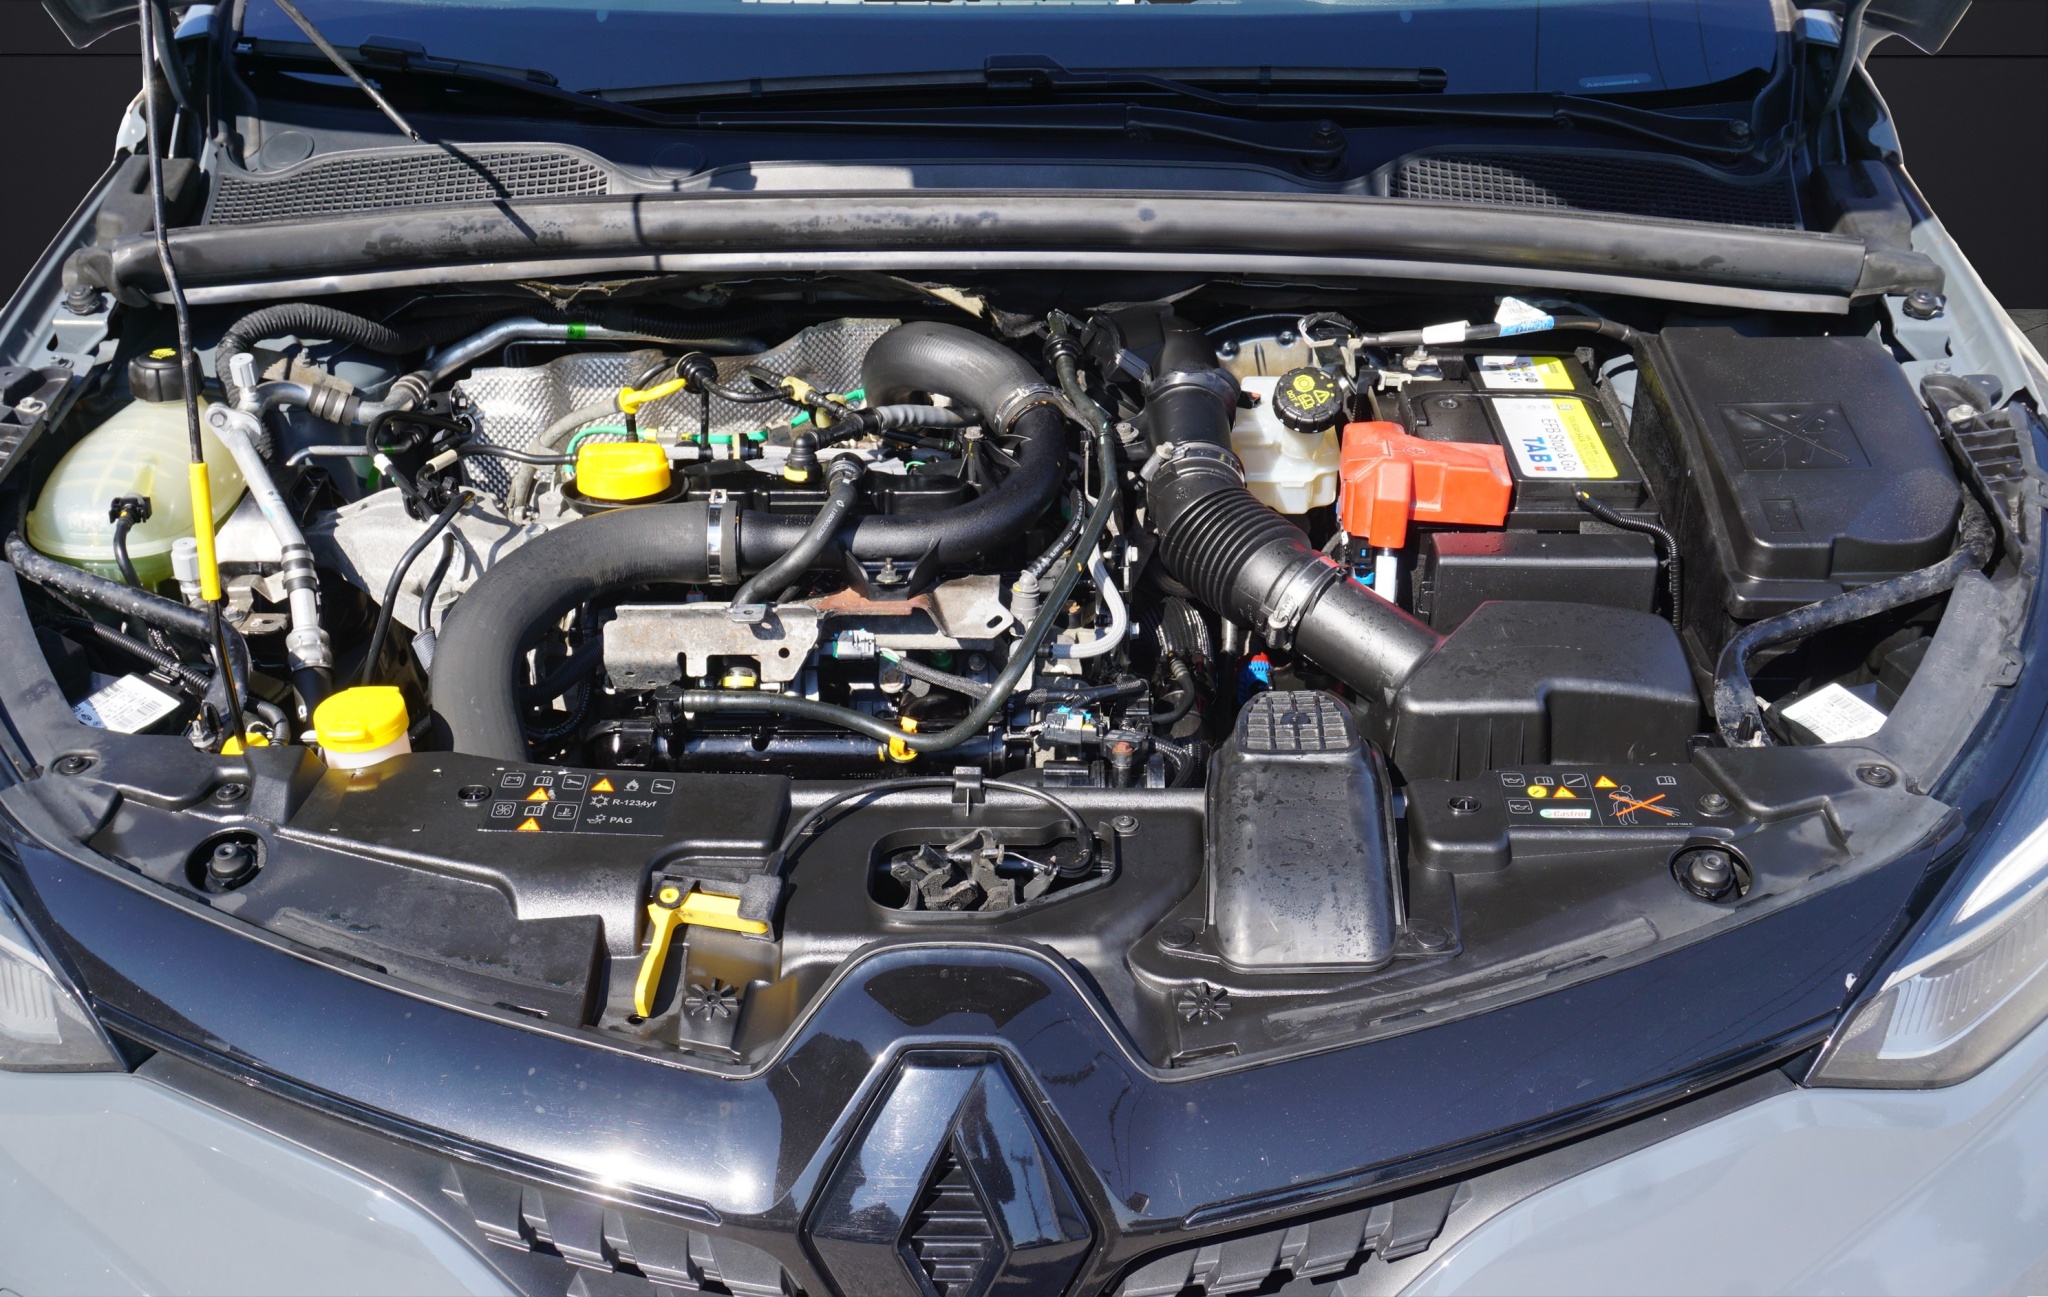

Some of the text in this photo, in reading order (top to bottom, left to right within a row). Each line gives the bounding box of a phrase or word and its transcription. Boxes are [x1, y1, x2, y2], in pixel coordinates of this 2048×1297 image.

[1287, 390, 1298, 401] DOT
[1541, 418, 1561, 433] EFB
[1549, 434, 1566, 452] Stop
[1522, 436, 1553, 463] TAB
[1561, 460, 1577, 472] Go
[612, 798, 657, 808] R-1234yf
[609, 816, 633, 824] PAG
